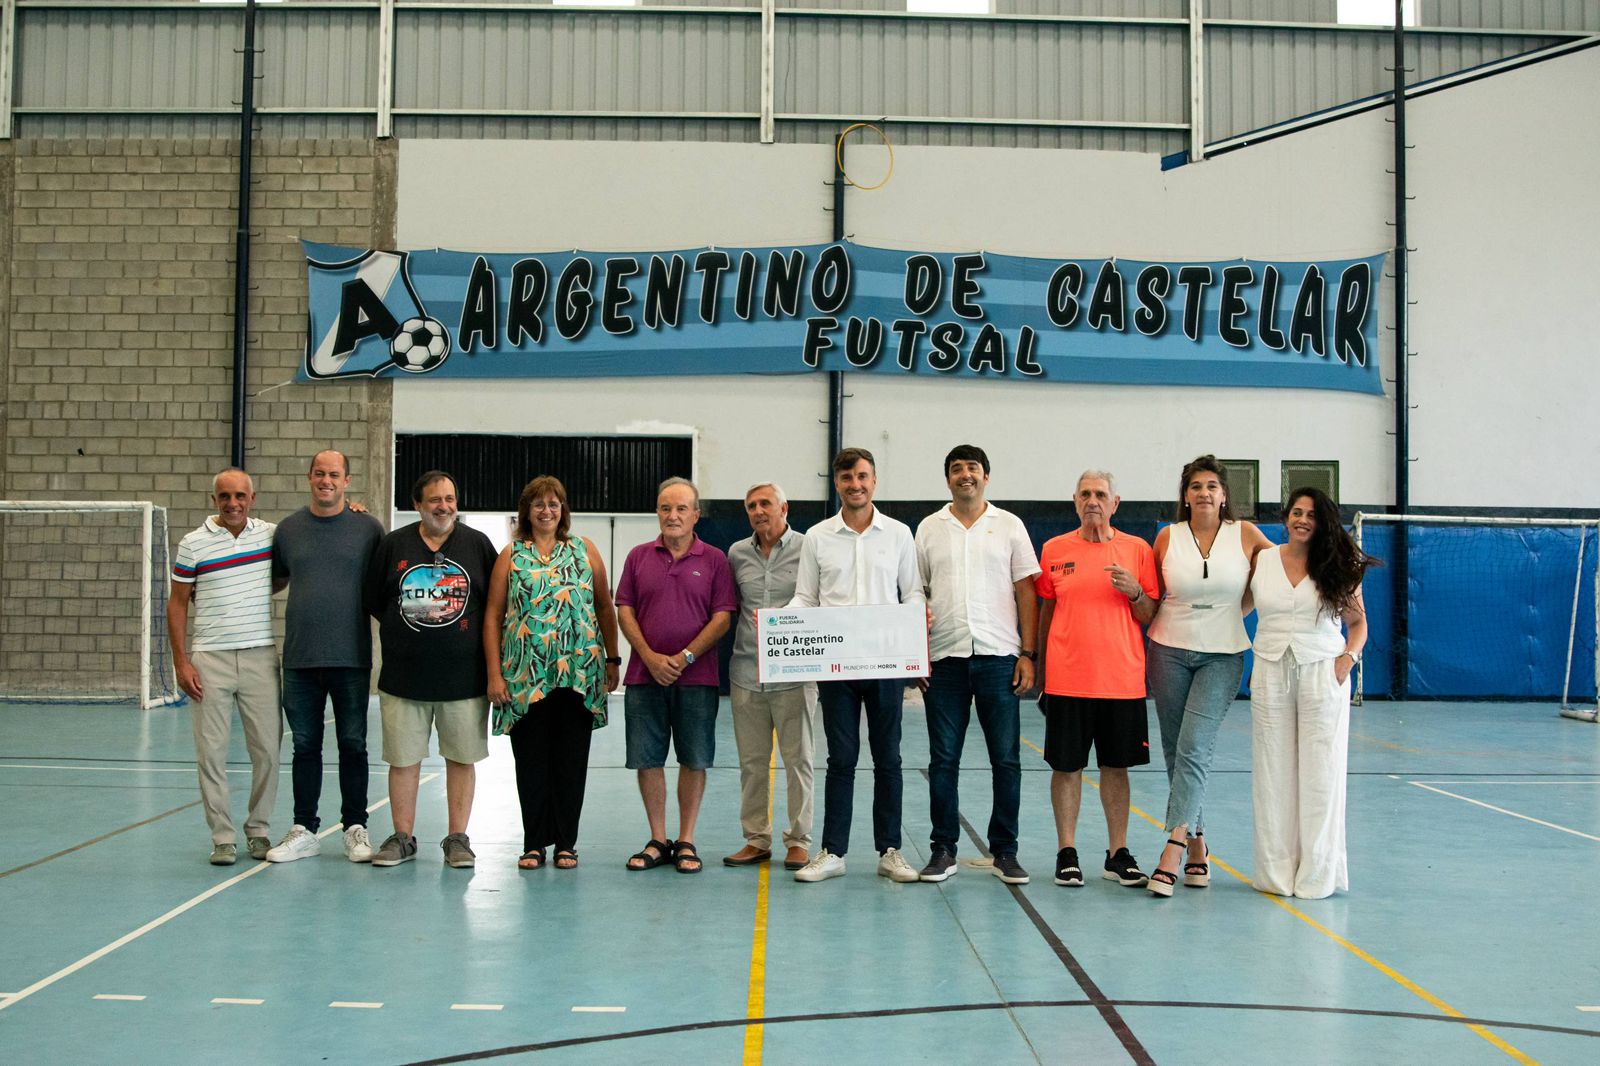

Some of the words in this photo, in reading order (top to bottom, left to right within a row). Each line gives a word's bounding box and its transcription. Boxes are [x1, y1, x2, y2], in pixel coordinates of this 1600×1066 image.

[457, 244, 850, 354] ARGENTINO
[904, 253, 985, 320] DE
[1045, 262, 1371, 368] CASTELAR
[802, 316, 1043, 376] FUTSAL
[404, 588, 462, 598] TOKYO
[767, 636, 789, 646] Club
[792, 634, 844, 646] Argentino
[767, 648, 780, 657] de
[783, 647, 825, 657] Castelar
